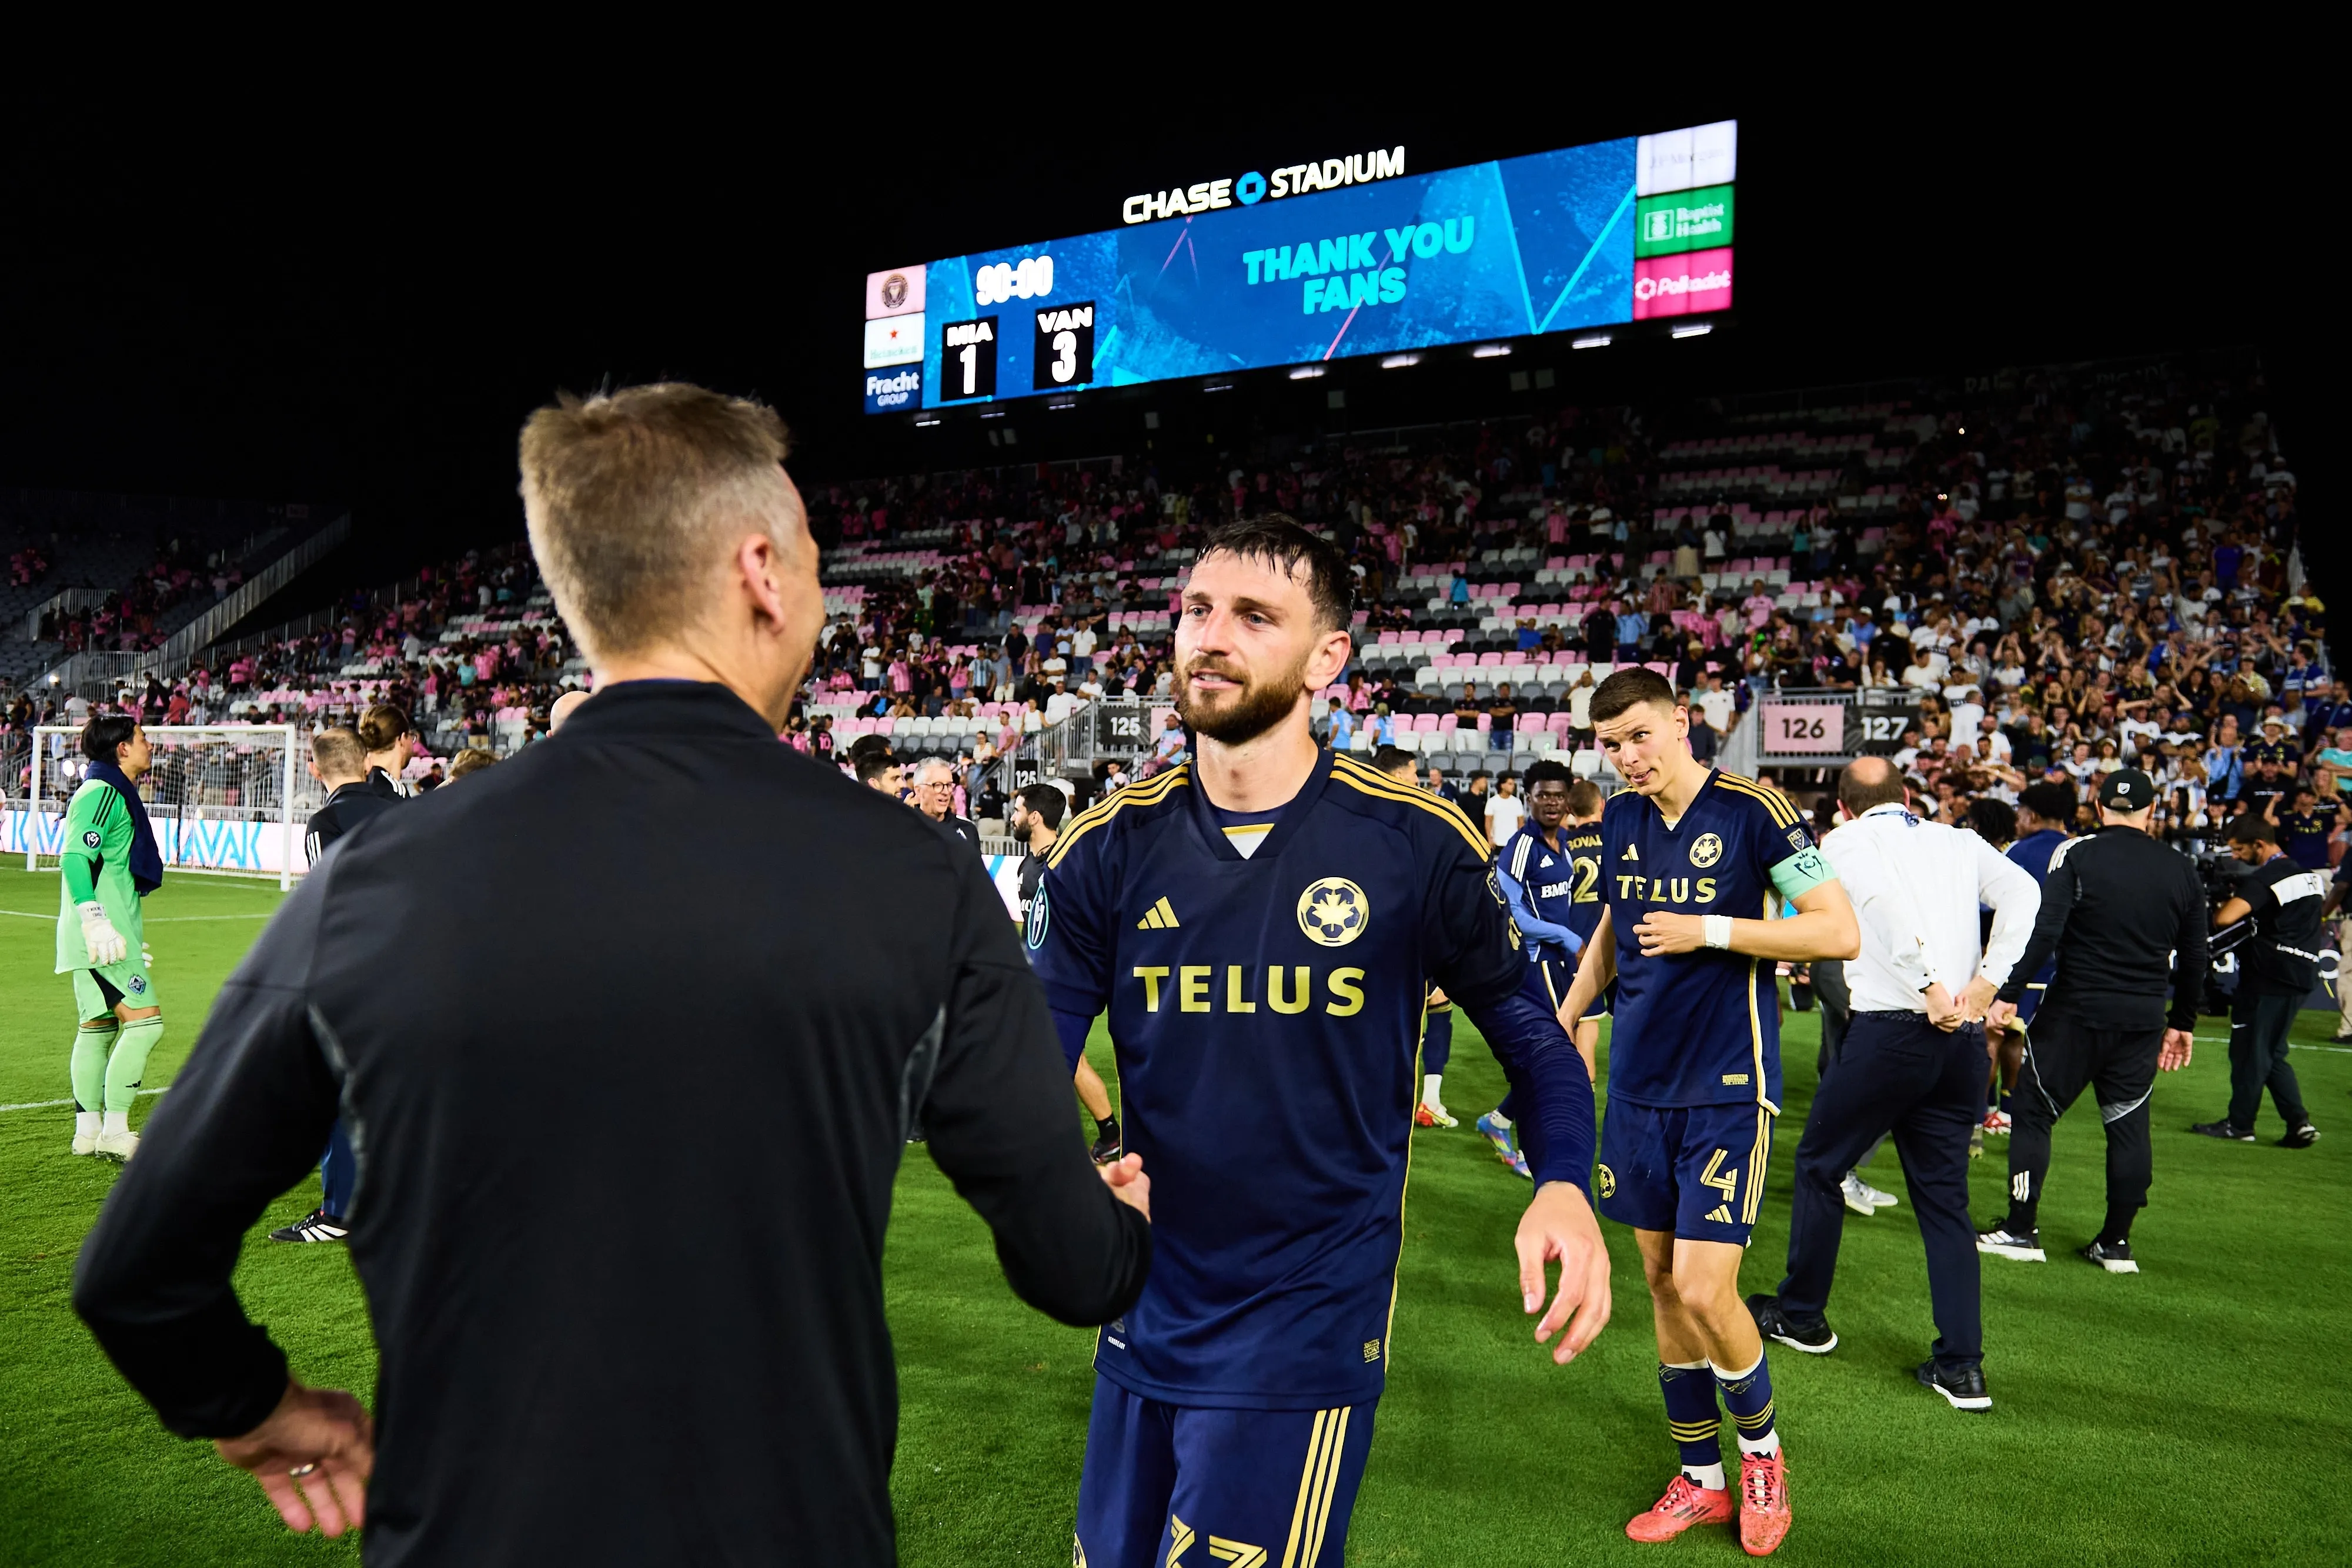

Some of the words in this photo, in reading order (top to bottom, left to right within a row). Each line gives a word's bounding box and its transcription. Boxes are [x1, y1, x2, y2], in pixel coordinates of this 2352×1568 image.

[1122, 178, 1232, 224] CHASE
[1270, 145, 1405, 198] STADIUM
[1242, 231, 1378, 285] THANK
[1384, 215, 1475, 263] YOU
[976, 255, 1054, 306] 90:00
[1303, 267, 1406, 315] FANS
[1656, 270, 1731, 297] Polkadot
[1037, 306, 1093, 333] VAN
[947, 322, 994, 347] MIA
[960, 344, 977, 394] 1
[1051, 330, 1077, 383] 3
[866, 371, 920, 396] Fracht
[877, 392, 909, 407] GROUP
[1110, 717, 1141, 735] 125
[1782, 717, 1825, 738] 126
[1860, 716, 1909, 741] 127
[818, 736, 831, 750] 10
[1015, 770, 1037, 788] 125
[165, 817, 263, 870] KAVAK
[1541, 881, 1568, 899] BMO
[1616, 875, 1716, 904] TELUS
[1132, 965, 1366, 1017] TELUS
[1699, 1148, 1738, 1202] 4
